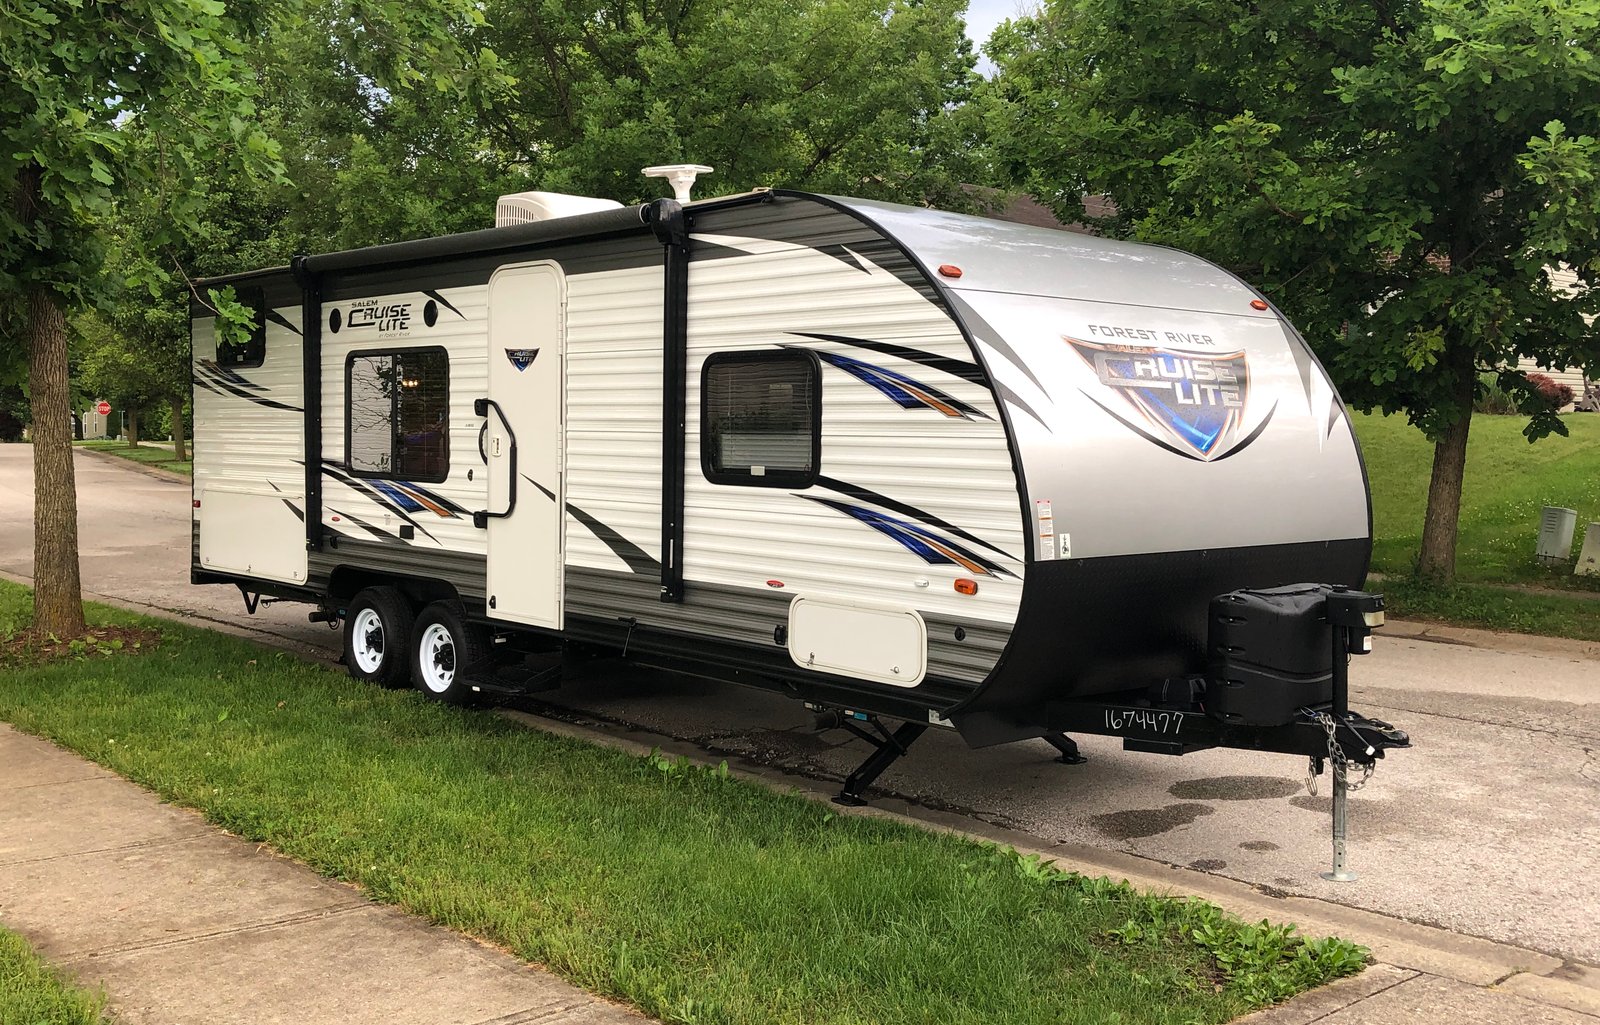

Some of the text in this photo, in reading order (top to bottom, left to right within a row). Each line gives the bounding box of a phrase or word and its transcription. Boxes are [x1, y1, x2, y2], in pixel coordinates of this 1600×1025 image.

[347, 304, 411, 328] CRUISE
[351, 300, 378, 308] SALEM
[379, 318, 411, 332] LITE
[1088, 324, 1215, 345] FOREST RIVER
[1094, 352, 1237, 388] CRUISE
[1174, 381, 1243, 408] LITE
[1105, 709, 1184, 734] 1674477
